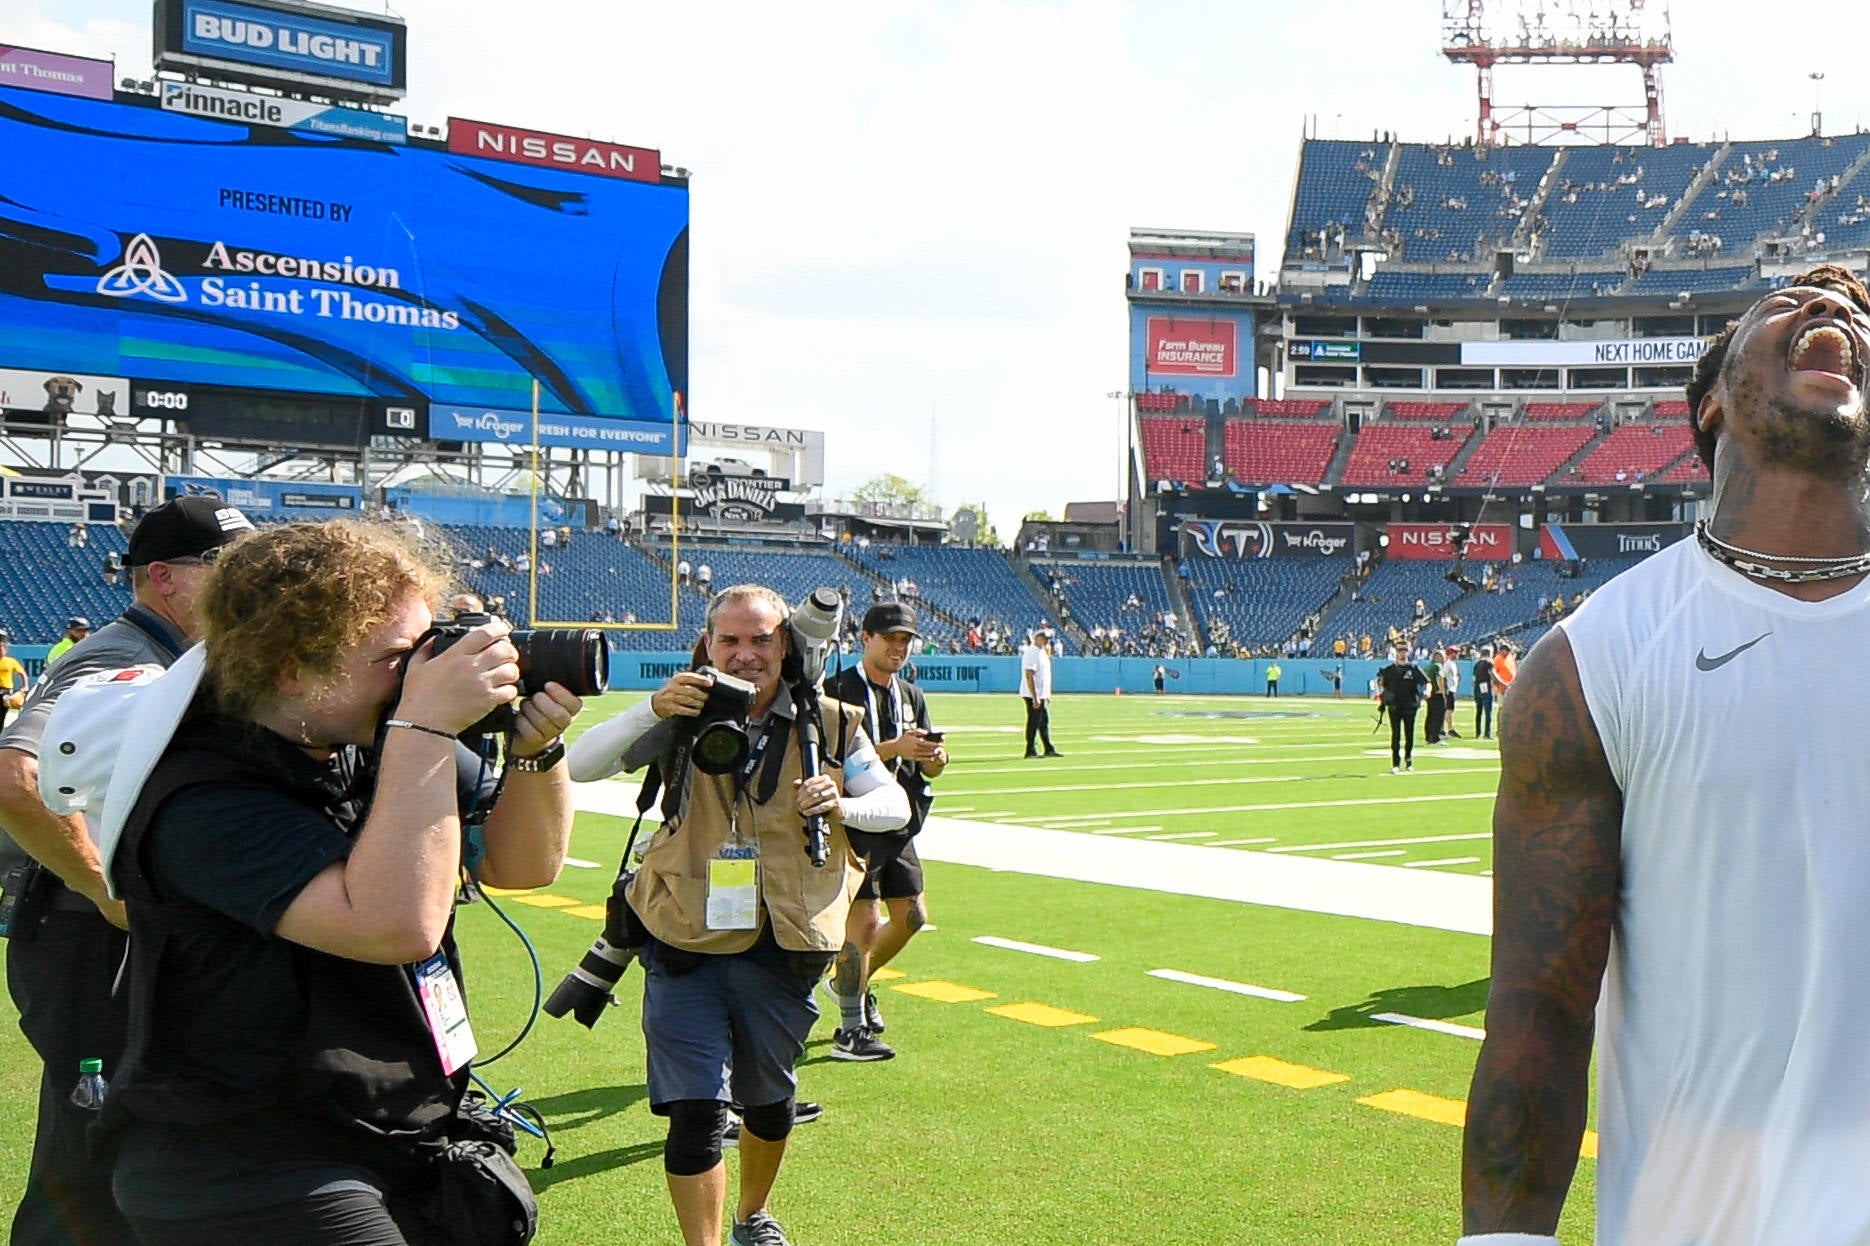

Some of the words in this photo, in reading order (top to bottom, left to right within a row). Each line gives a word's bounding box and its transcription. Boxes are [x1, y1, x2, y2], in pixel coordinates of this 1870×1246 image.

[195, 14, 274, 49] BUD
[277, 28, 382, 67] LIGHT
[21, 62, 85, 84] Thomas
[166, 84, 283, 124] Pinnacle
[477, 129, 635, 173] NISSAN
[218, 188, 325, 220] PRESENTED
[330, 204, 353, 223] BY
[201, 240, 400, 289] Ascension
[200, 276, 304, 314] Saint
[310, 287, 460, 330] Thomas
[1157, 350, 1224, 363] INSURANCE
[1158, 340, 1186, 351] Farm
[1595, 343, 1629, 362] NEXT
[1633, 342, 1673, 361] HOME
[1676, 341, 1709, 360] GAM
[147, 391, 188, 410] 0:00
[475, 412, 525, 438] Kroger
[537, 423, 569, 438] RESH
[572, 425, 598, 439] FOR
[689, 422, 804, 444] NISSAN
[1303, 530, 1346, 555] Kroger
[1617, 533, 1661, 553] TITANS
